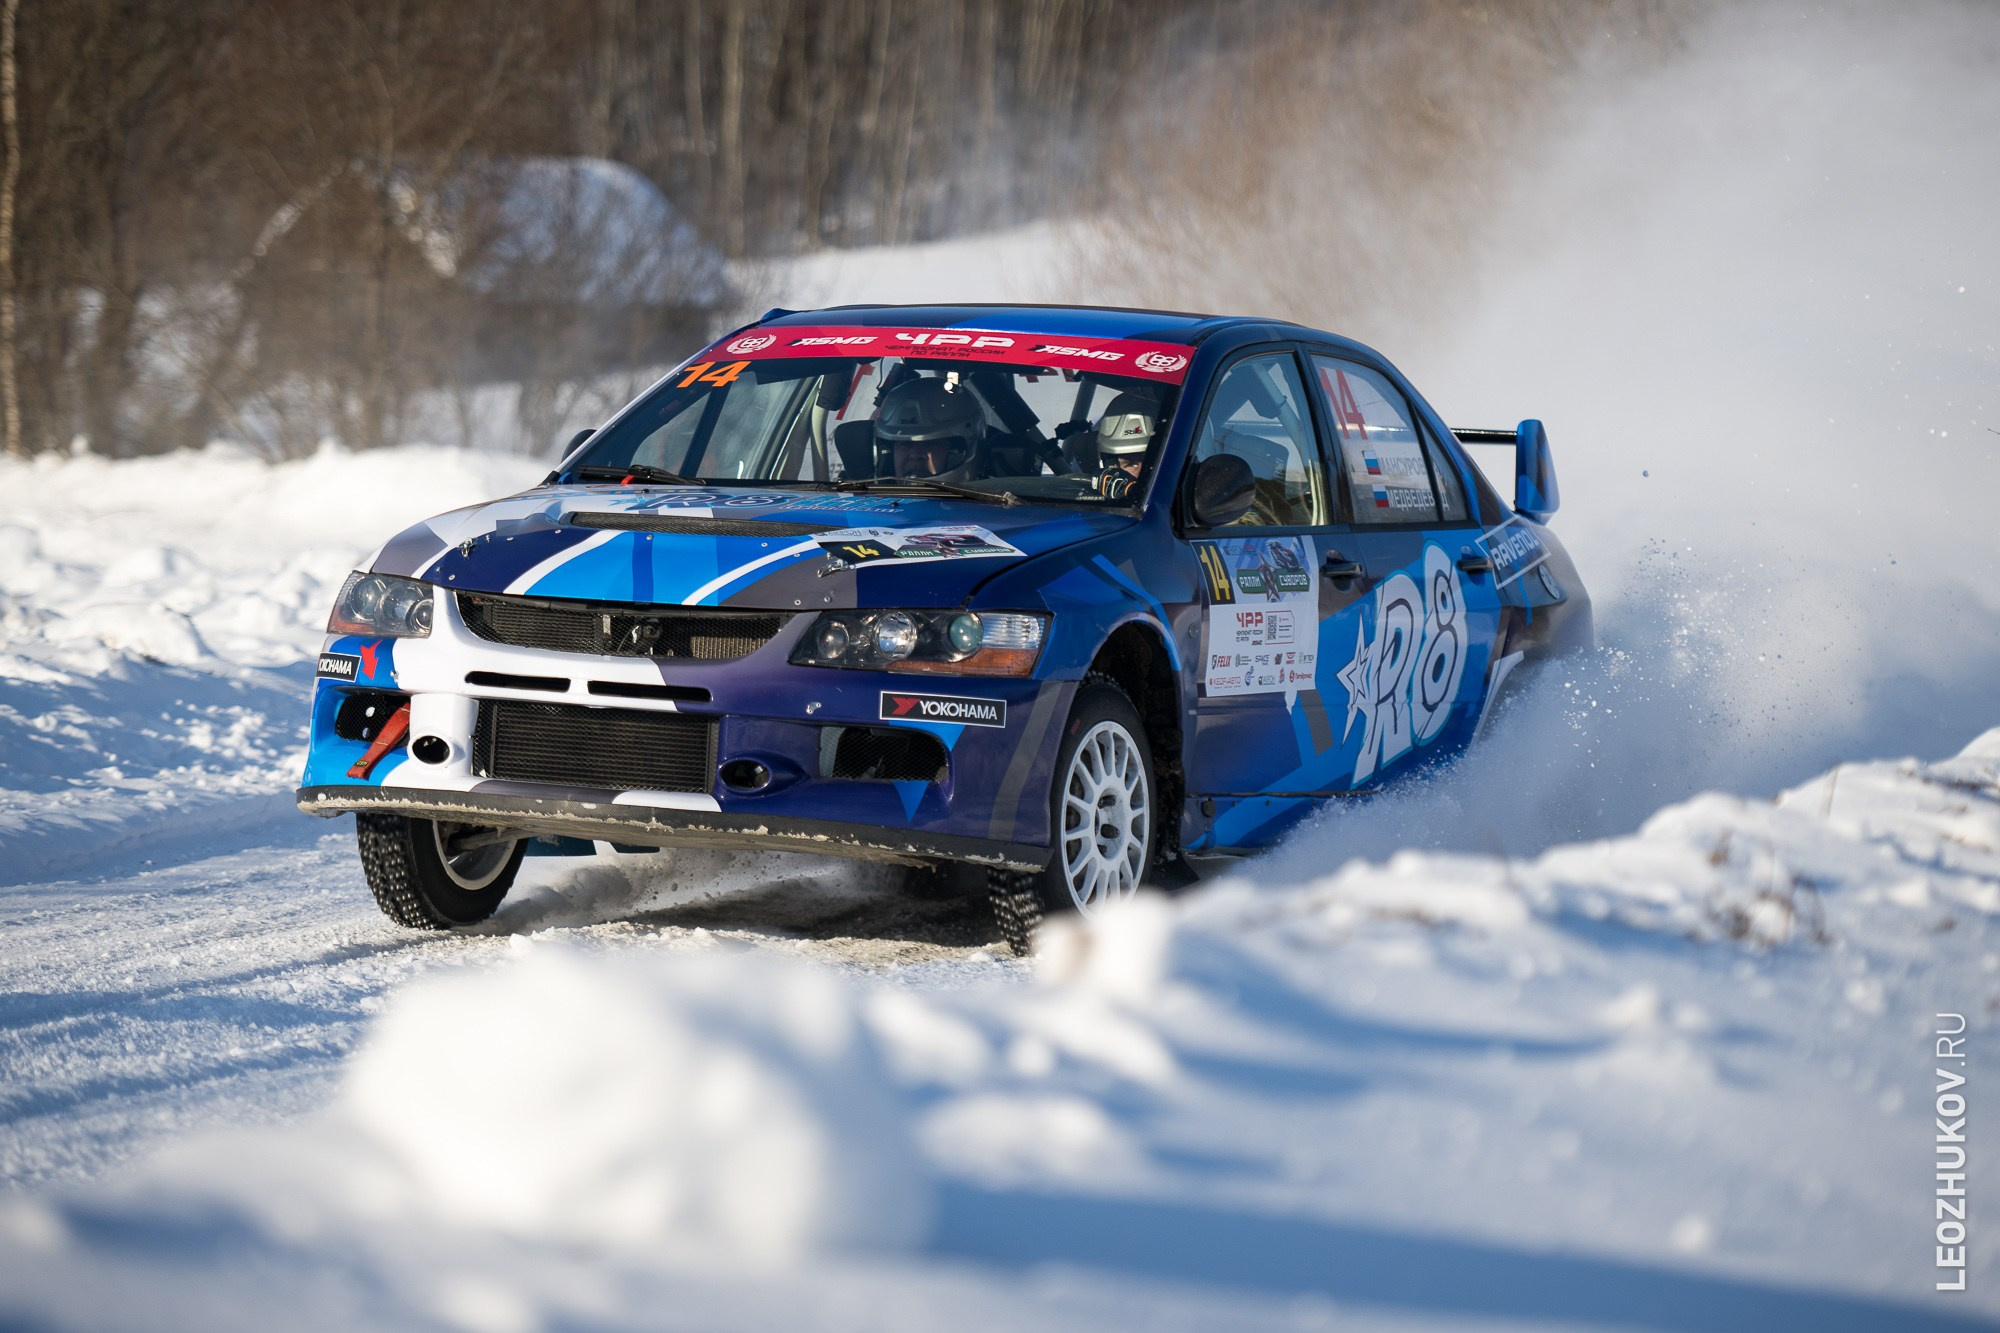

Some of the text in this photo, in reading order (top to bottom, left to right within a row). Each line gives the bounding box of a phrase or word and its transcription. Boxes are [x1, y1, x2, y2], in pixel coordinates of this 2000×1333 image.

[895, 333, 1015, 347] ЧРР
[957, 347, 1006, 355] РОССИИ
[676, 361, 751, 388] 14
[1320, 368, 1368, 440] 14
[842, 544, 879, 558] 14
[1490, 528, 1540, 571] RAVENOL
[1200, 546, 1231, 600] 14
[1239, 574, 1308, 587] РАЛЛИ СУВОРОВ
[920, 700, 997, 720] YOKOHAMA
